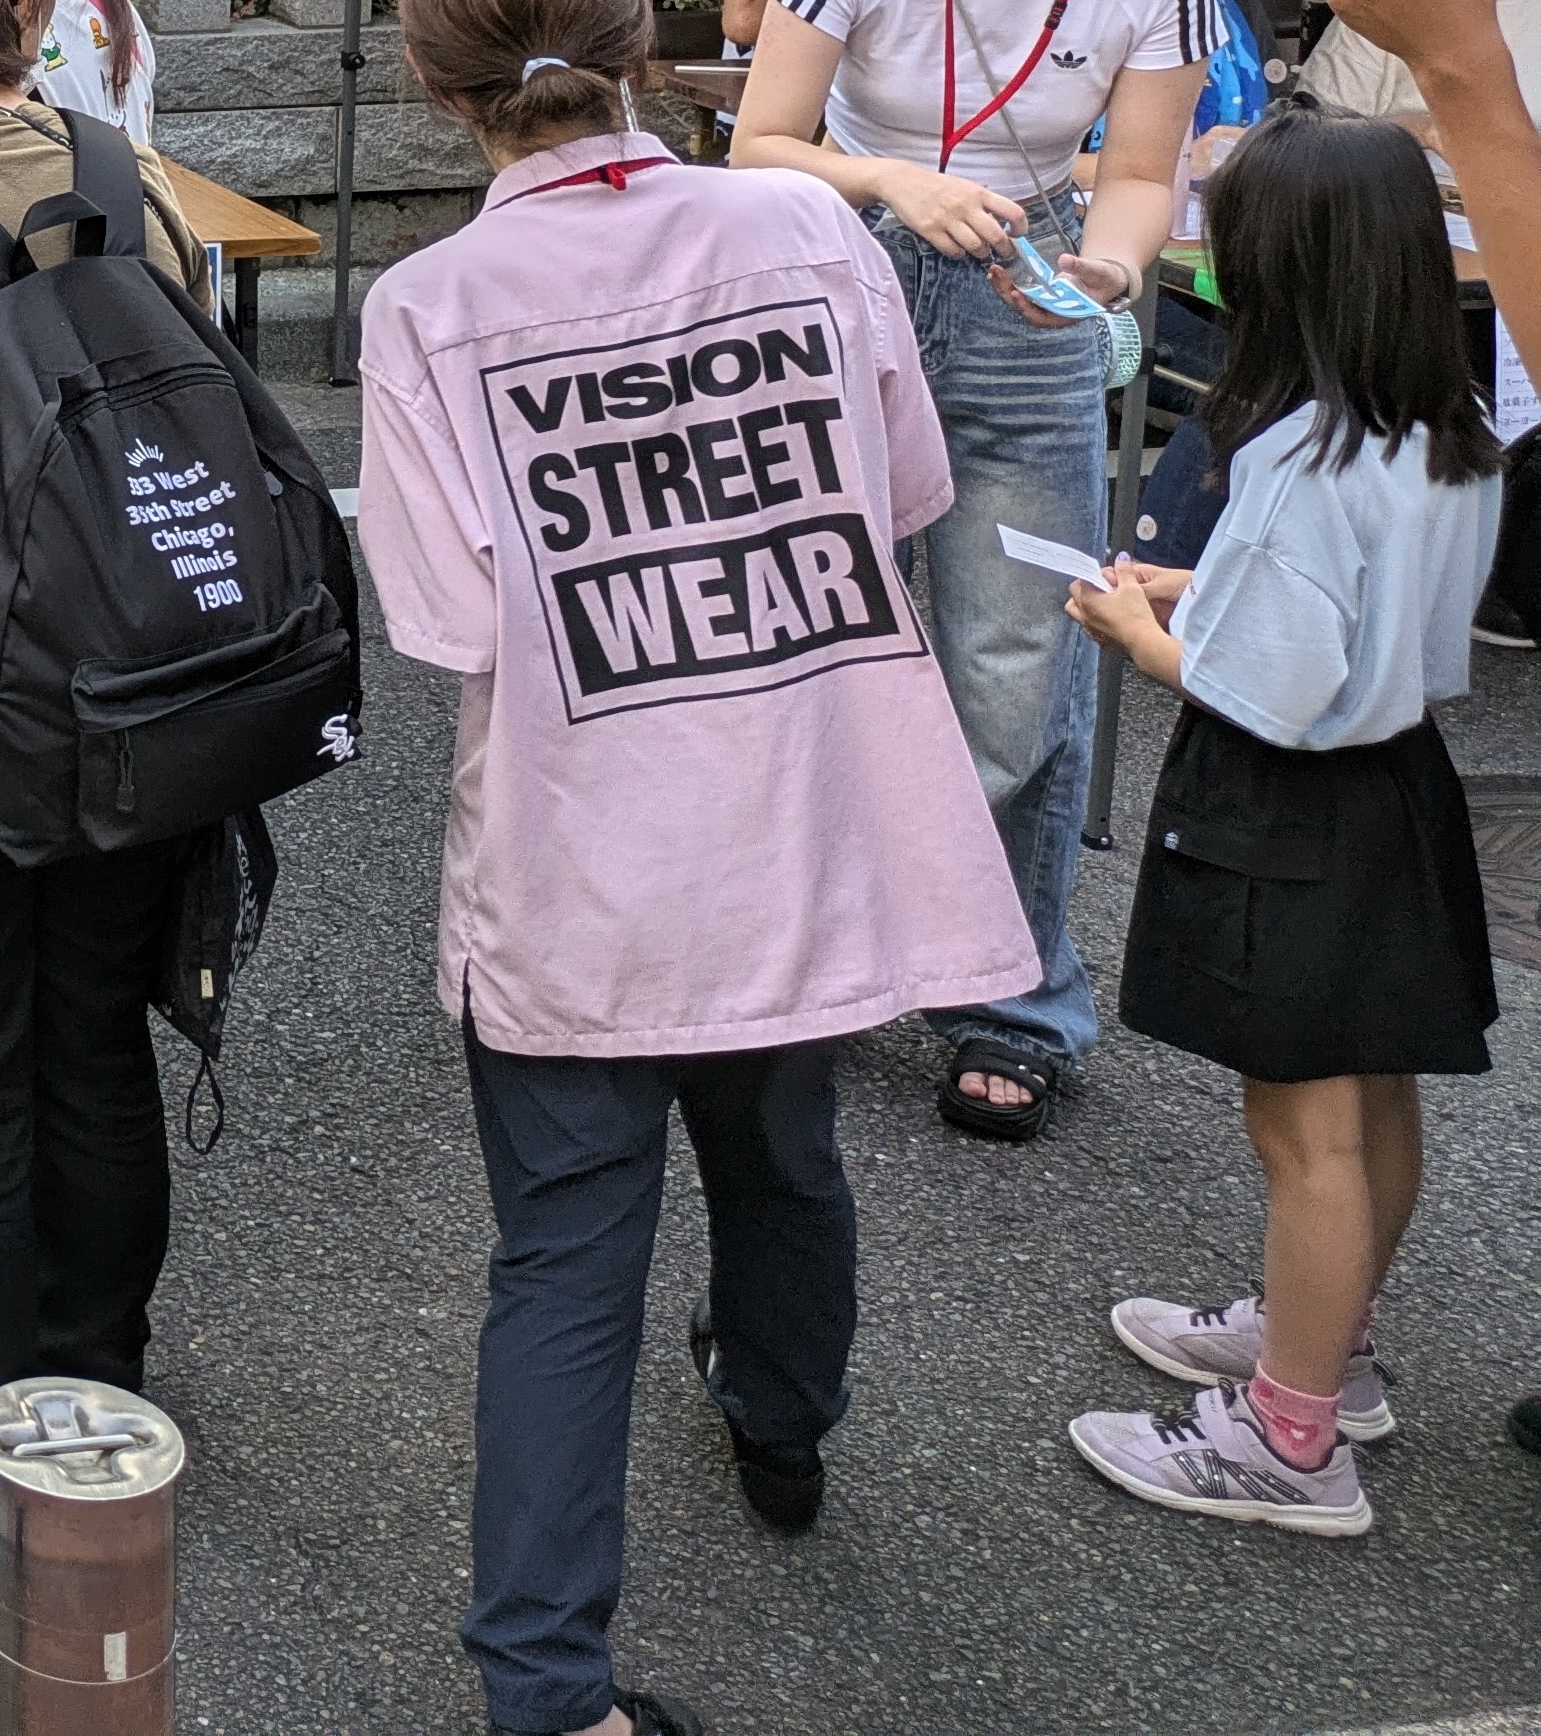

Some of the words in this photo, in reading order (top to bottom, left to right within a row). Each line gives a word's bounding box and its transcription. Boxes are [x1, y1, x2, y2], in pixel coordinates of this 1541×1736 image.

[504, 323, 834, 434] VISION
[156, 460, 210, 491] West
[527, 397, 843, 553] STREET
[125, 501, 172, 526] 35th
[171, 480, 236, 518] Street
[151, 522, 235, 552] Chicago,
[171, 549, 238, 580] Illinois
[193, 579, 244, 612] 1900
[575, 531, 870, 675] WEAR
